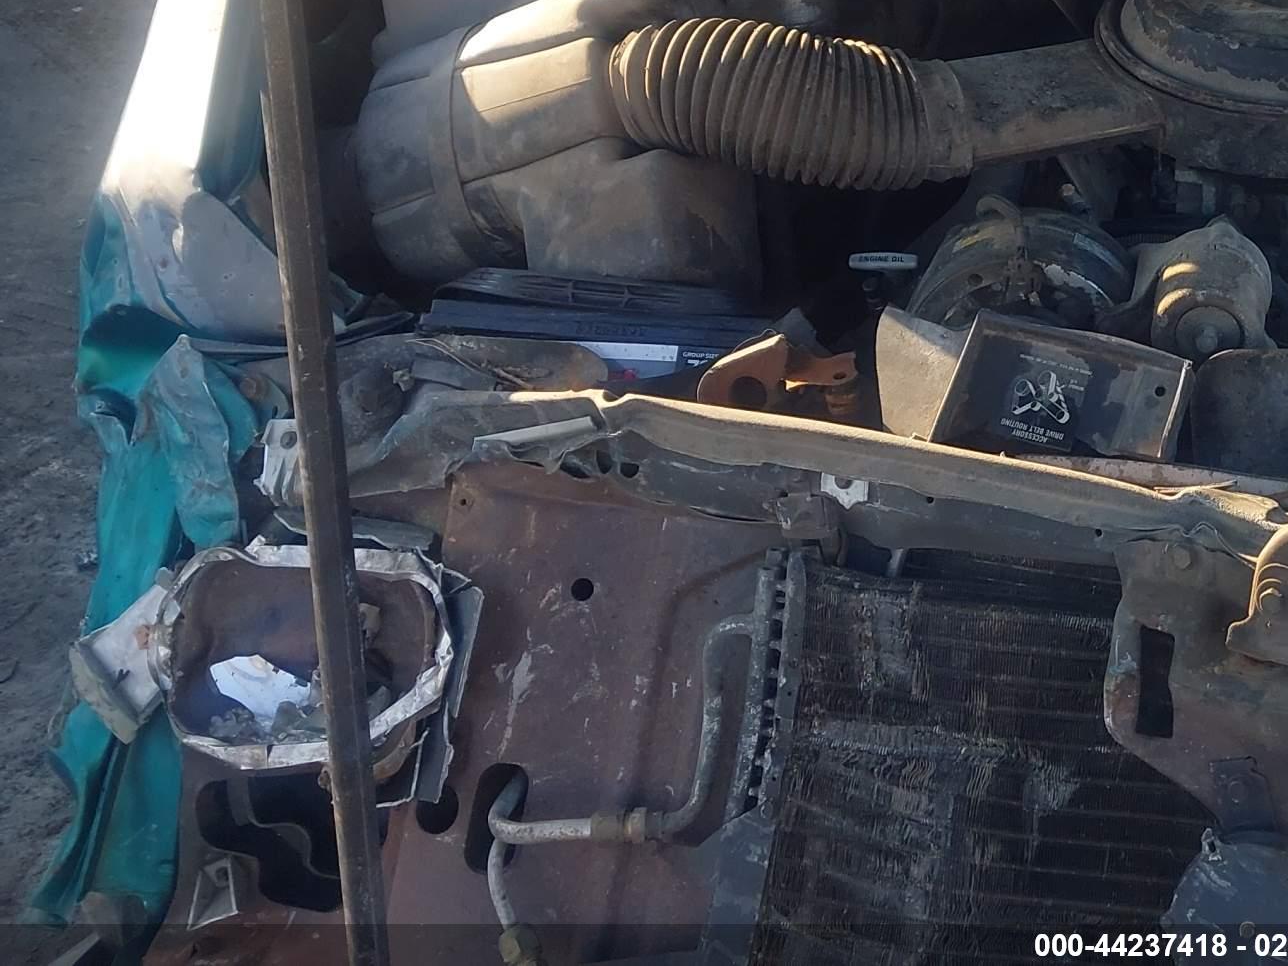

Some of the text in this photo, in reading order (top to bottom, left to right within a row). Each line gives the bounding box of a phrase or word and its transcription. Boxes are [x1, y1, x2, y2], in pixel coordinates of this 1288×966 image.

[891, 255, 905, 263] OIL
[1000, 418, 1065, 440] DRIVE BELT ROUTING
[1011, 430, 1048, 443] ACCESSORY
